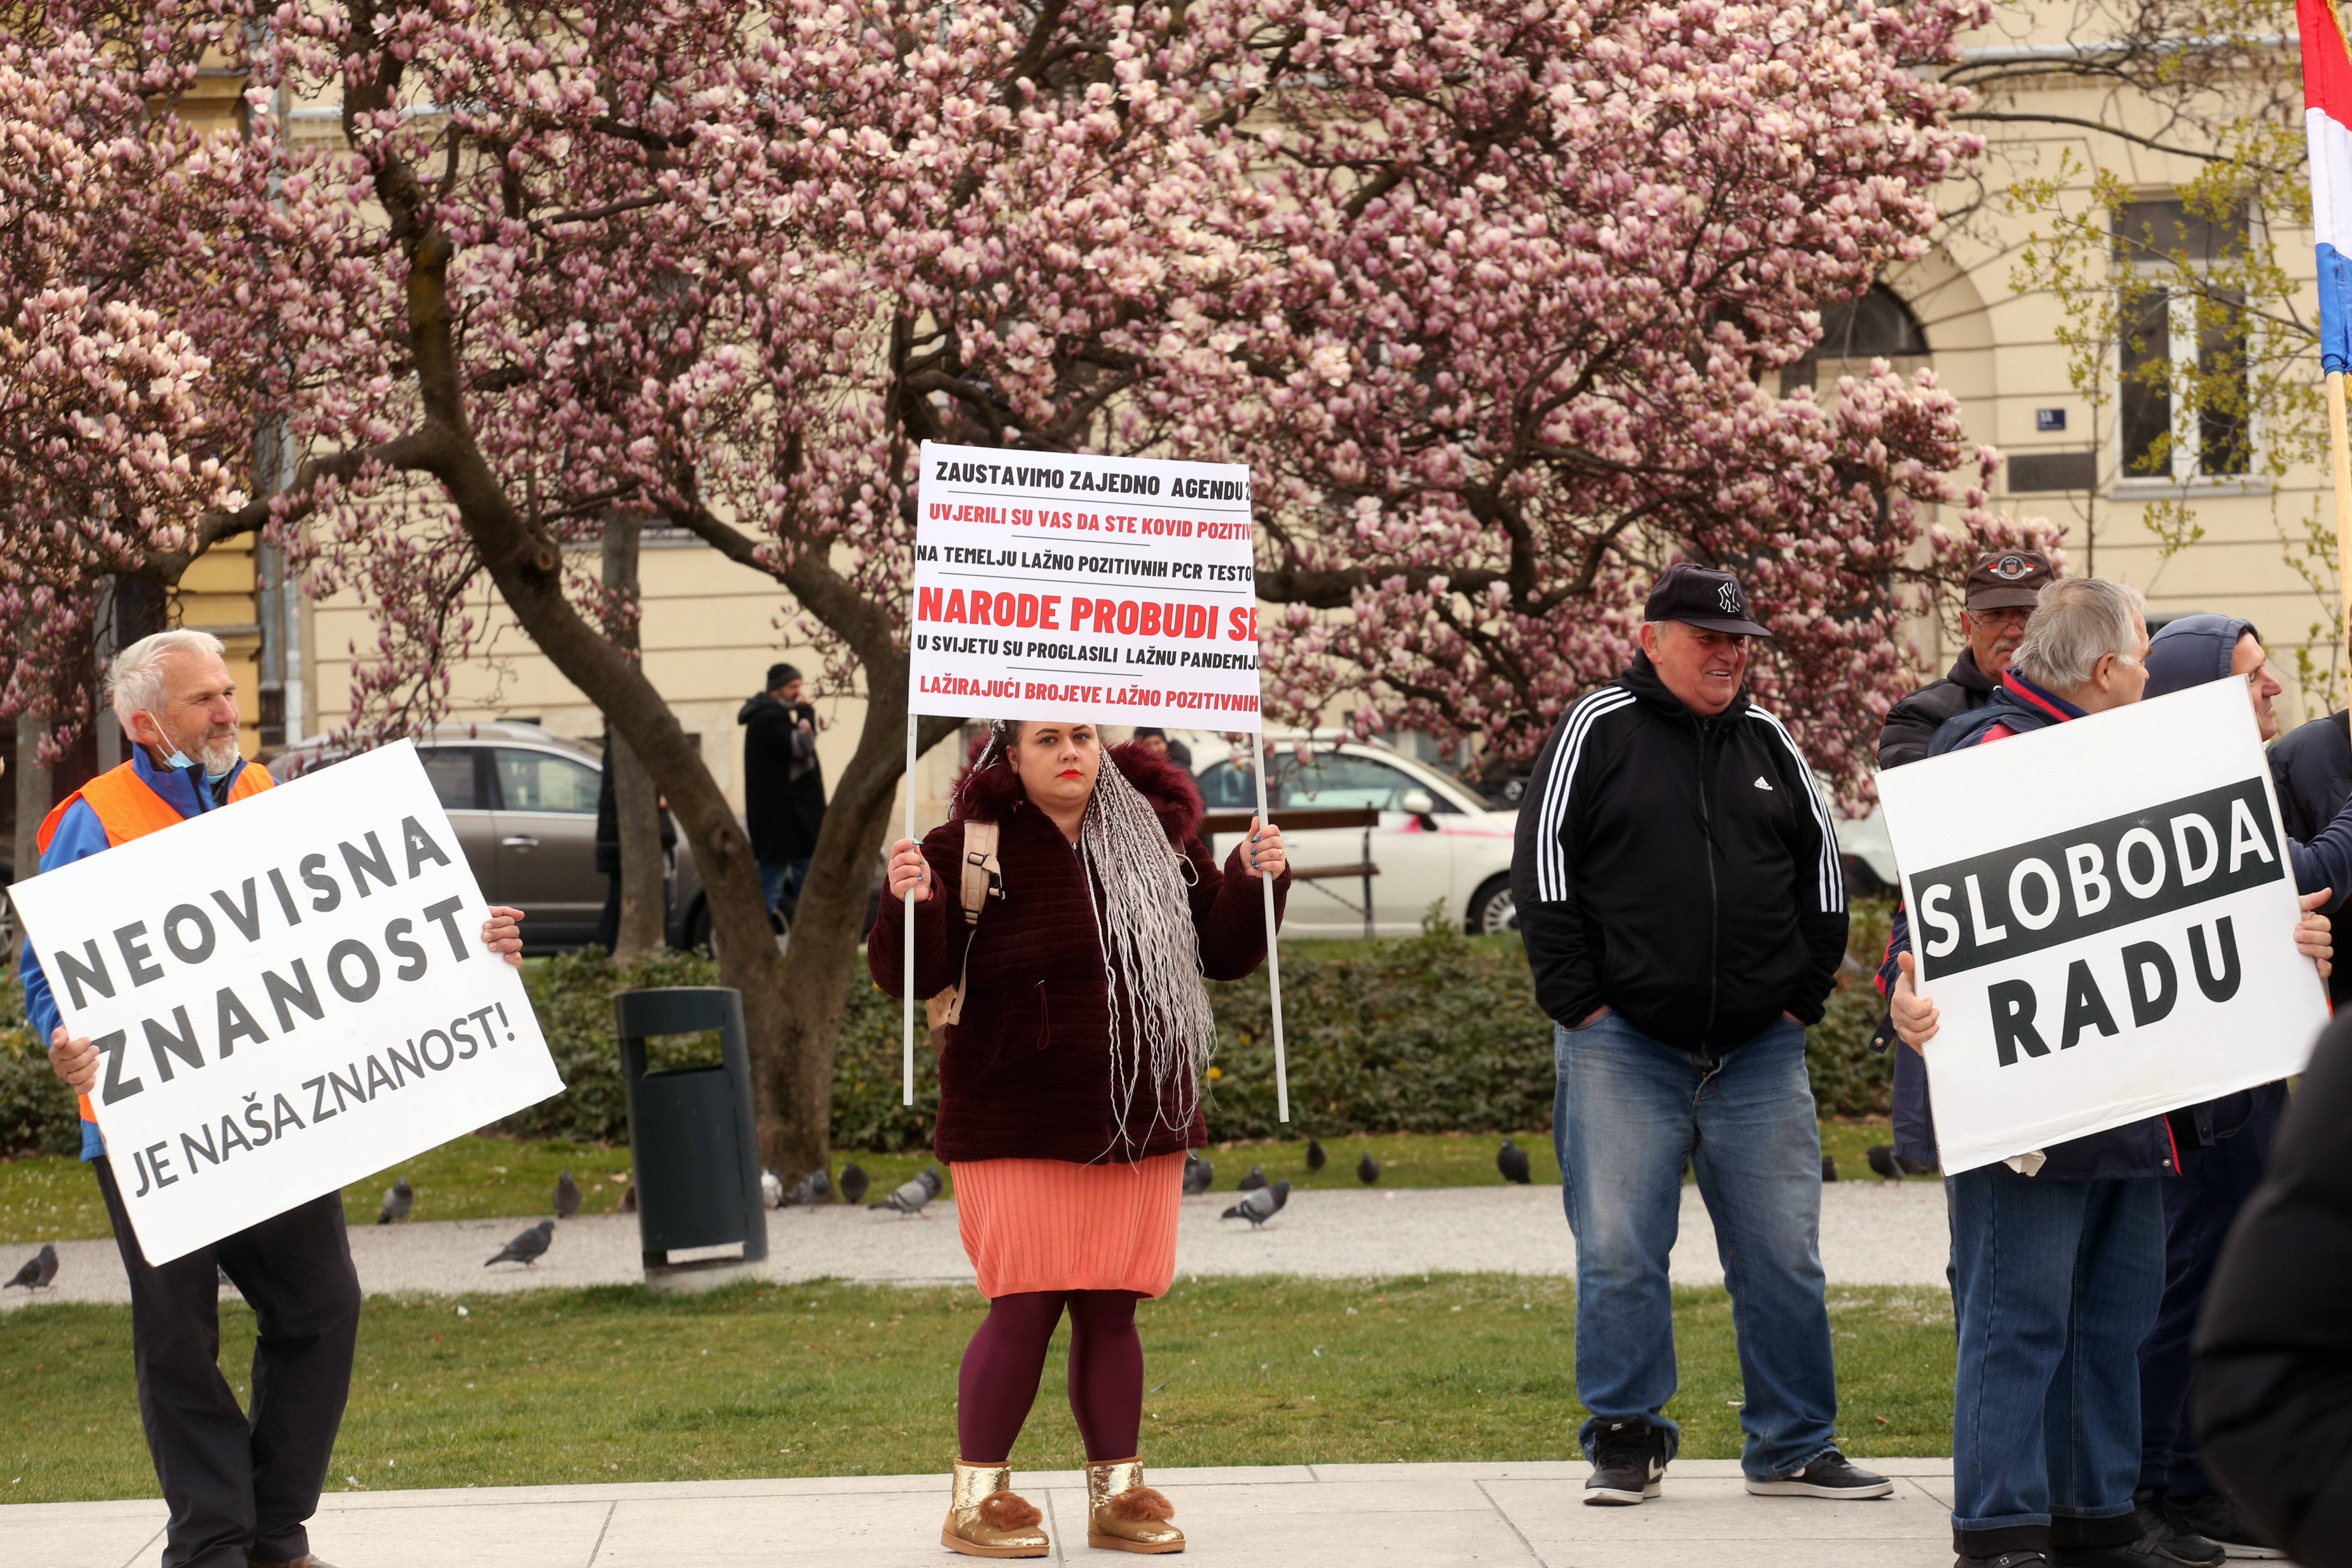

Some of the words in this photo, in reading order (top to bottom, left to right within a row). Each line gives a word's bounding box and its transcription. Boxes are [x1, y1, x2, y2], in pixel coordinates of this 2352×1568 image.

[936, 461, 1064, 488] ZAUSTAVIMO
[1070, 471, 1160, 495] ZAJEDNO
[1171, 478, 1242, 500] AGENDU
[930, 503, 1006, 524] UVJERILI
[1011, 509, 1032, 526] SU
[1039, 511, 1072, 528] VAS
[1077, 513, 1099, 530] DA
[1105, 515, 1137, 533] STE
[1142, 518, 1192, 537] KOVID
[1197, 522, 1252, 540] POZITIV
[917, 545, 938, 561] NA
[944, 547, 1017, 567] TEMELJU
[1022, 550, 1074, 570] LAŽNO
[1078, 556, 1167, 577] POZITIVNIH
[1172, 563, 1203, 579] PCR
[918, 587, 1061, 630] NARODE
[1070, 597, 1218, 639] PROBUDI
[1228, 607, 1258, 641] SE
[918, 635, 927, 650] U
[932, 636, 998, 655] SVIJETU
[1003, 641, 1022, 656] SU
[1027, 642, 1118, 662] PROGLASILI
[1126, 646, 1176, 666] LAŽNU
[920, 673, 1020, 698] LAŽIRAJUĆI
[1025, 683, 1102, 703] BROJEVE
[1106, 685, 1161, 706] LAŽNO
[1165, 691, 1258, 712] POZITIVNIH
[1921, 798, 2274, 958] SLOBODA
[55, 816, 452, 1010] NEOVISNA
[91, 895, 469, 1106] ZNANOST
[1988, 916, 2241, 1067] RADU
[134, 1141, 179, 1197] JE
[180, 1092, 306, 1174] NAŠA
[302, 1002, 515, 1124] ZNANOST!
